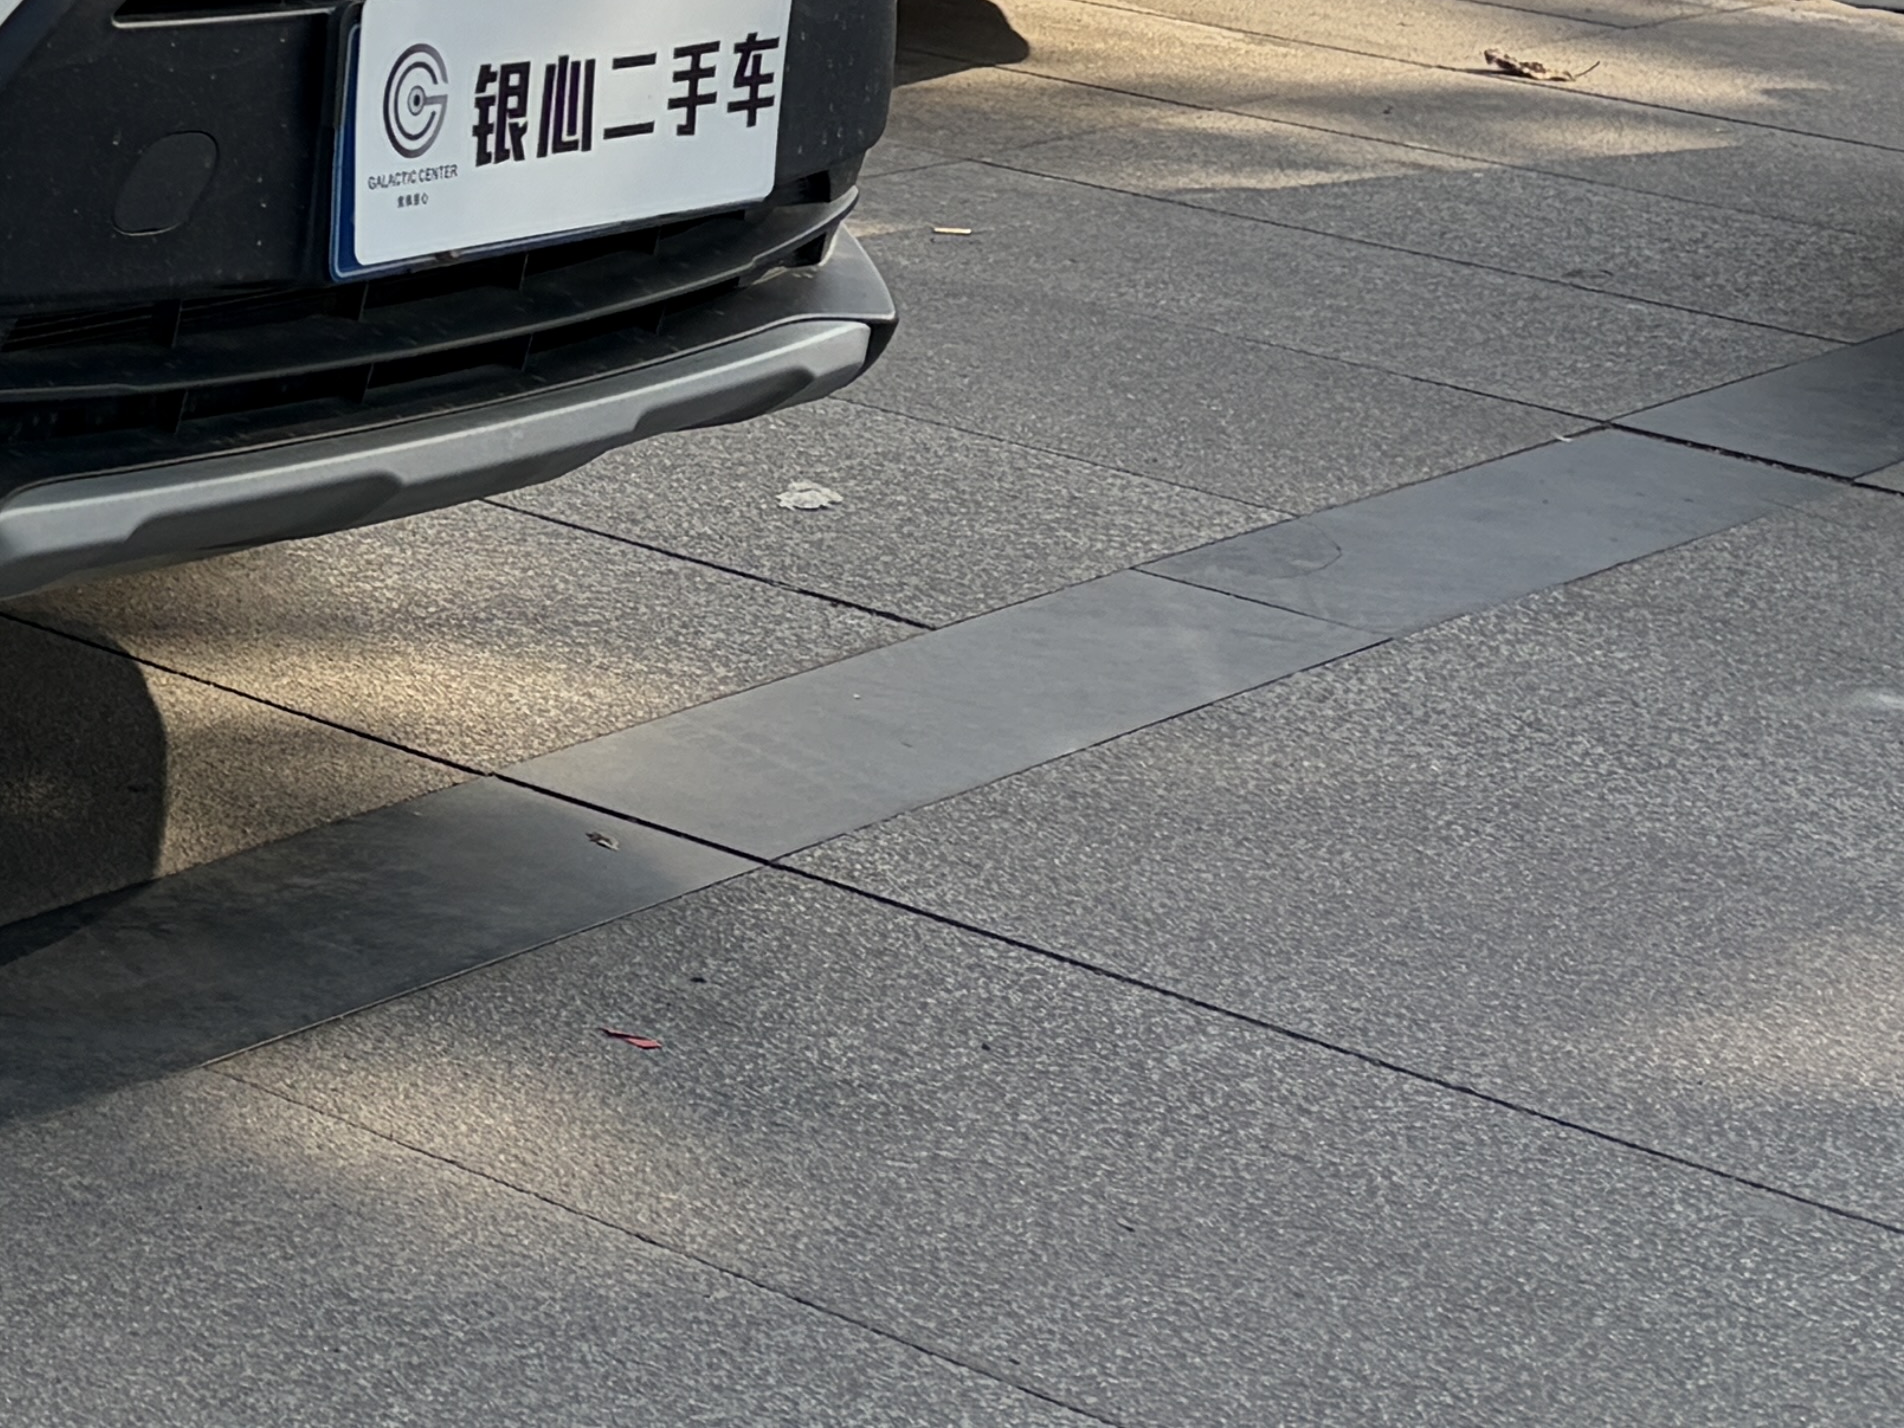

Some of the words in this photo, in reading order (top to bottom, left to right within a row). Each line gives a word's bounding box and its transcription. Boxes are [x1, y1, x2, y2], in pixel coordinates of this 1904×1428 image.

[471, 31, 780, 168] 银心二手车
[368, 169, 417, 190] GALACTIC
[418, 163, 459, 183] CENTER
